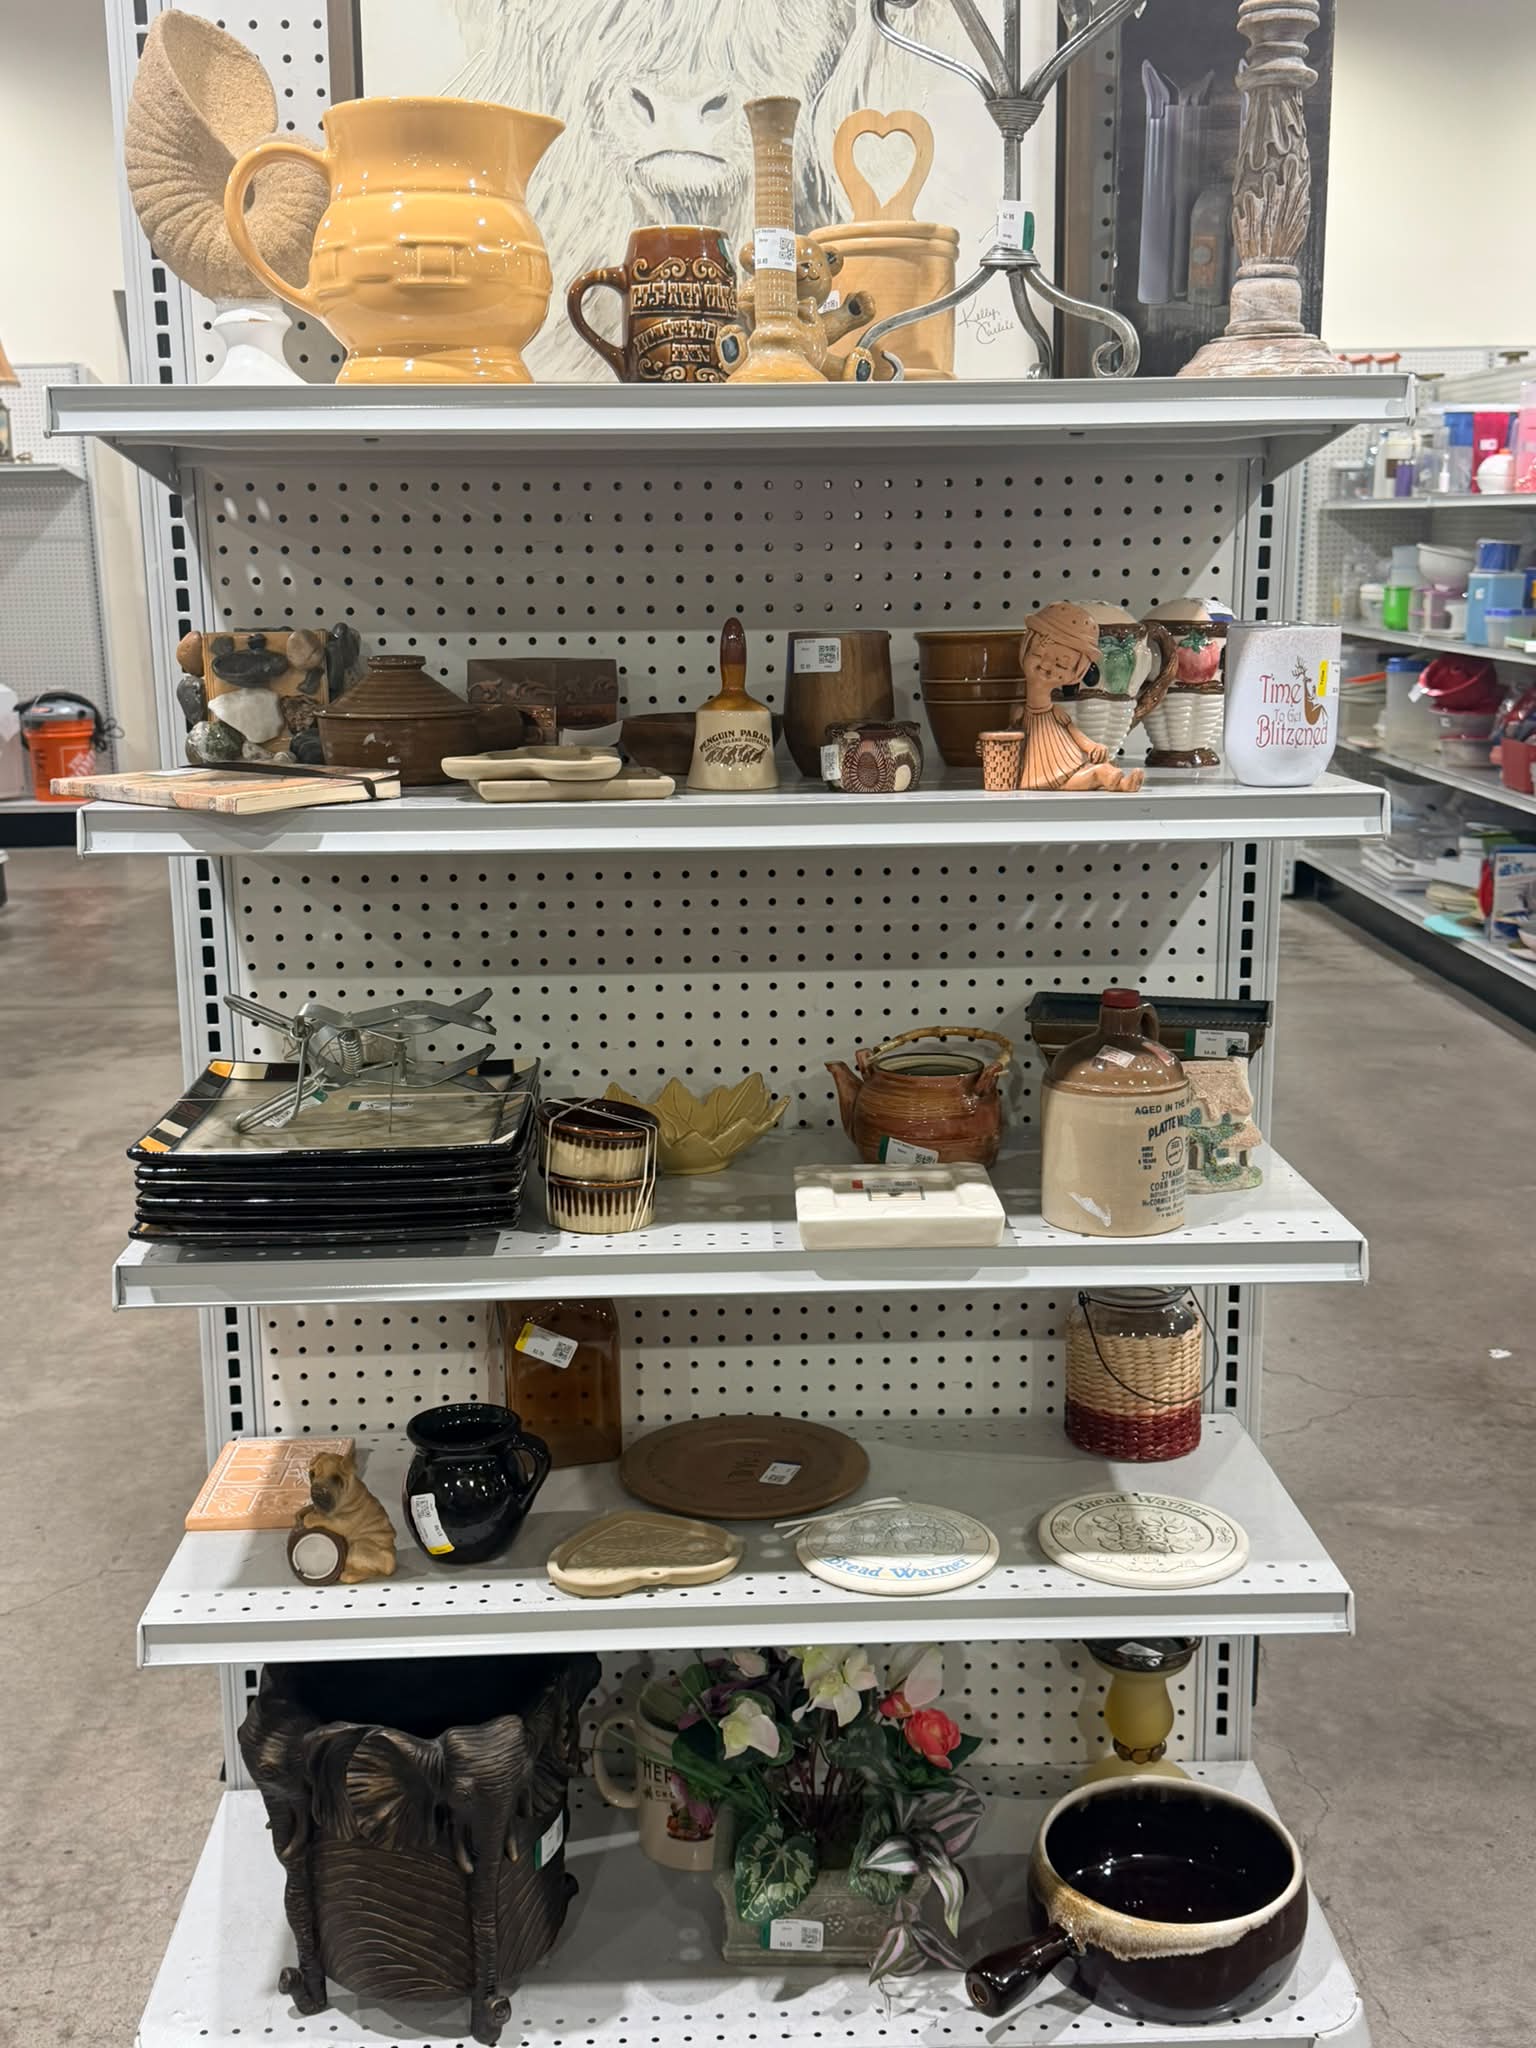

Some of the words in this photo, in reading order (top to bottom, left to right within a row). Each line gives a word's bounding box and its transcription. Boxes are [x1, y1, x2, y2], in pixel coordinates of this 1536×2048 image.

[1259, 673, 1302, 707] Time
[699, 730, 735, 752] PENGUIN
[1256, 714, 1328, 749] Blitzened
[1135, 1105, 1162, 1115] AGED
[1165, 1104, 1173, 1113] IN
[1175, 1099, 1186, 1110] THE
[1148, 1115, 1177, 1141] PLATTE
[1071, 1495, 1128, 1513] Bread
[1134, 1494, 1210, 1518] Warmer
[822, 1555, 882, 1578] Bread
[889, 1558, 972, 1579] Warmer
